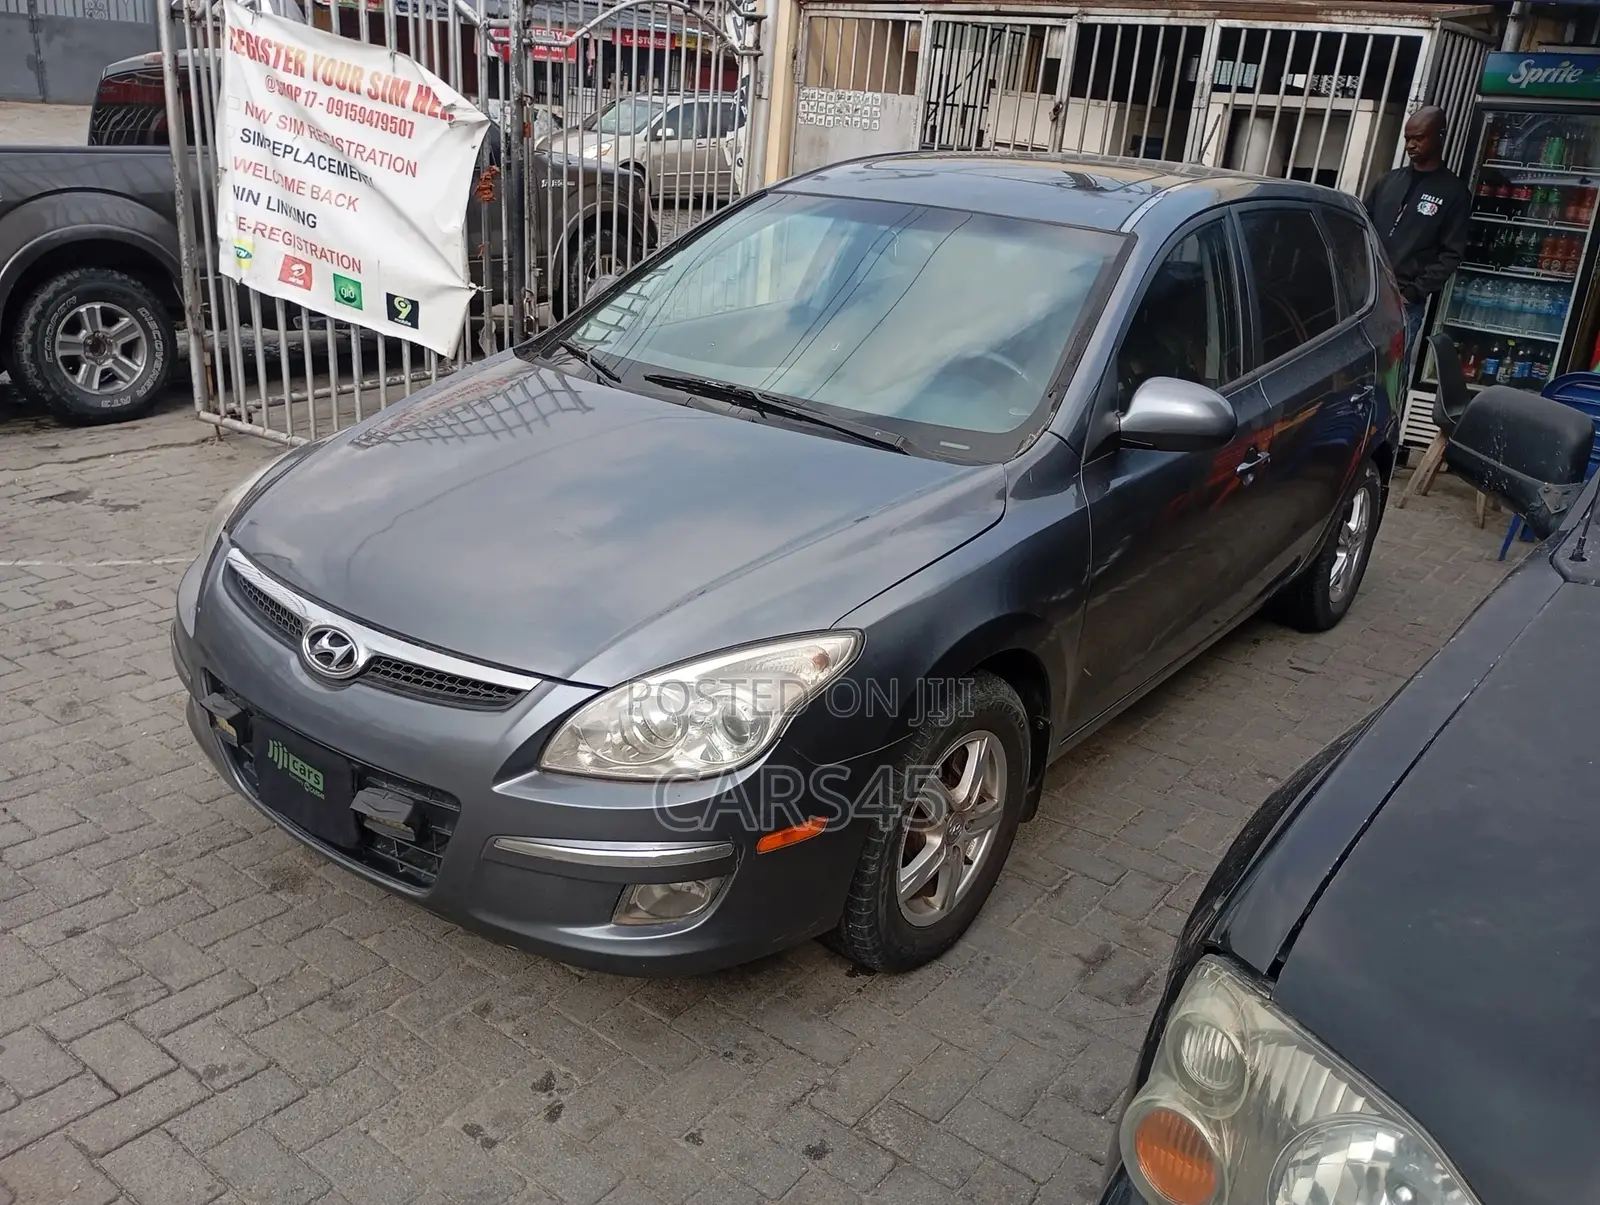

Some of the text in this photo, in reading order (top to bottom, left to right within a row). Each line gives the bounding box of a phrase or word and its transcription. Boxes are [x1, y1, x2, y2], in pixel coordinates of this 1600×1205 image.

[229, 25, 455, 121] REGISTER YOUR SIM HE
[1507, 59, 1584, 88] Sprite
[276, 114, 305, 137] SIM
[304, 90, 318, 108] 17
[326, 96, 415, 139] 09159479507
[310, 184, 359, 213] BACK
[44, 296, 77, 363] COOPER
